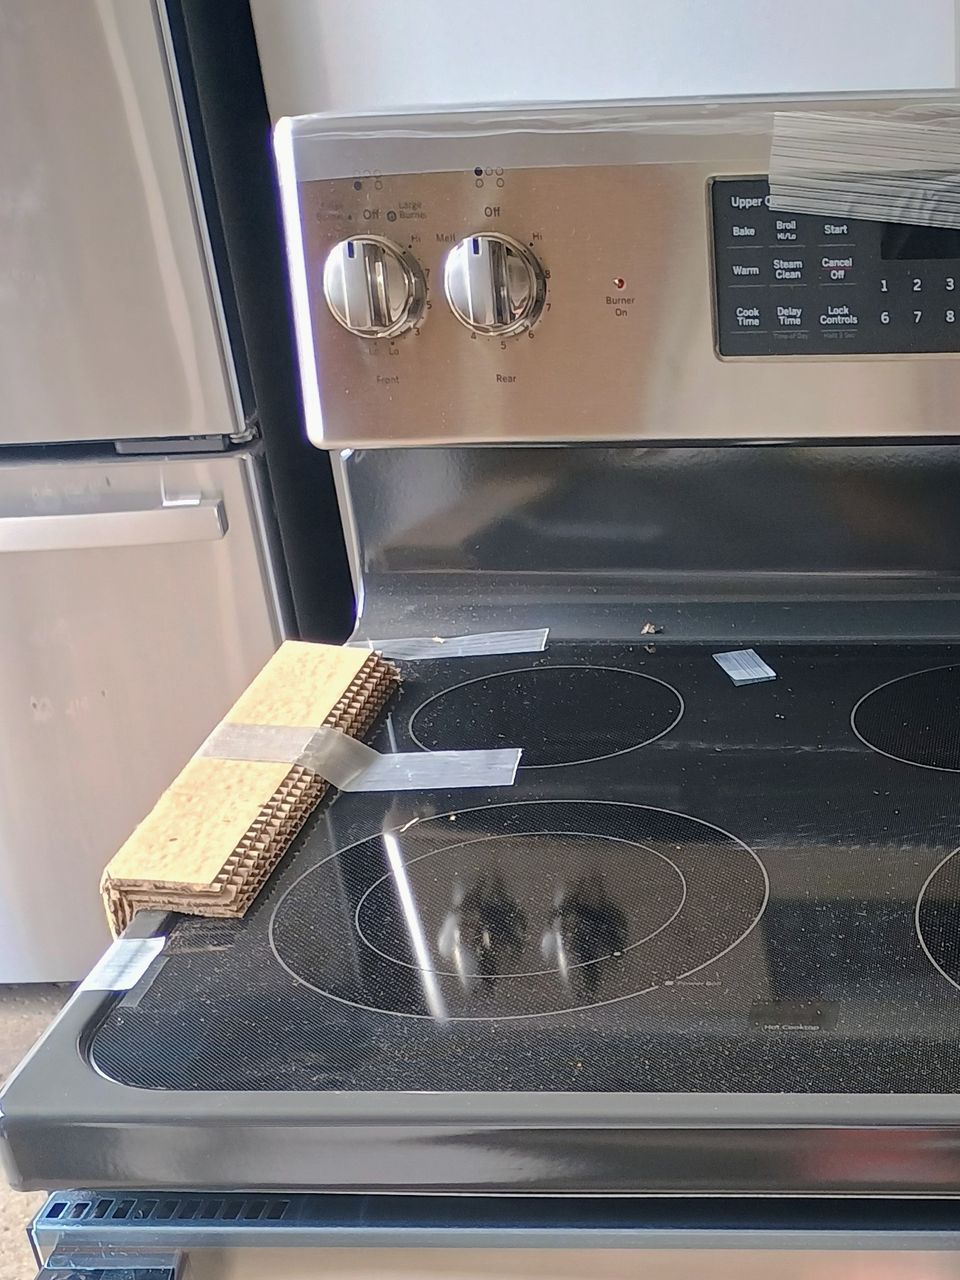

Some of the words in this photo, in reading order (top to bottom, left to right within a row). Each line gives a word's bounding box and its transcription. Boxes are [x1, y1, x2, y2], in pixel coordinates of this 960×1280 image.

[731, 196, 762, 208] Upper
[363, 208, 380, 220] Off
[484, 206, 501, 218] Off
[776, 220, 796, 230] Broil
[824, 224, 848, 235] Start
[532, 232, 543, 240] Hi
[732, 226, 755, 236] Bake
[776, 232, 796, 240] Hi/Lo
[773, 260, 803, 269] Steam
[822, 258, 852, 268] Cancel
[732, 266, 760, 276] Warm
[776, 270, 801, 279] Clean
[830, 270, 845, 280] Off
[880, 280, 888, 292] 1
[913, 279, 922, 291] 2
[946, 278, 954, 290] 3
[606, 296, 635, 306] Burner
[615, 308, 628, 318] On
[736, 308, 760, 317] Cook
[776, 307, 802, 318] Delay
[828, 306, 849, 316] Lock
[736, 316, 760, 326] Time
[779, 316, 801, 325] Time
[820, 315, 858, 324] Controls
[880, 312, 890, 324] 6
[914, 312, 922, 324] 7
[946, 310, 955, 322] 8
[376, 374, 400, 385] Front
[496, 374, 516, 384] Rear
